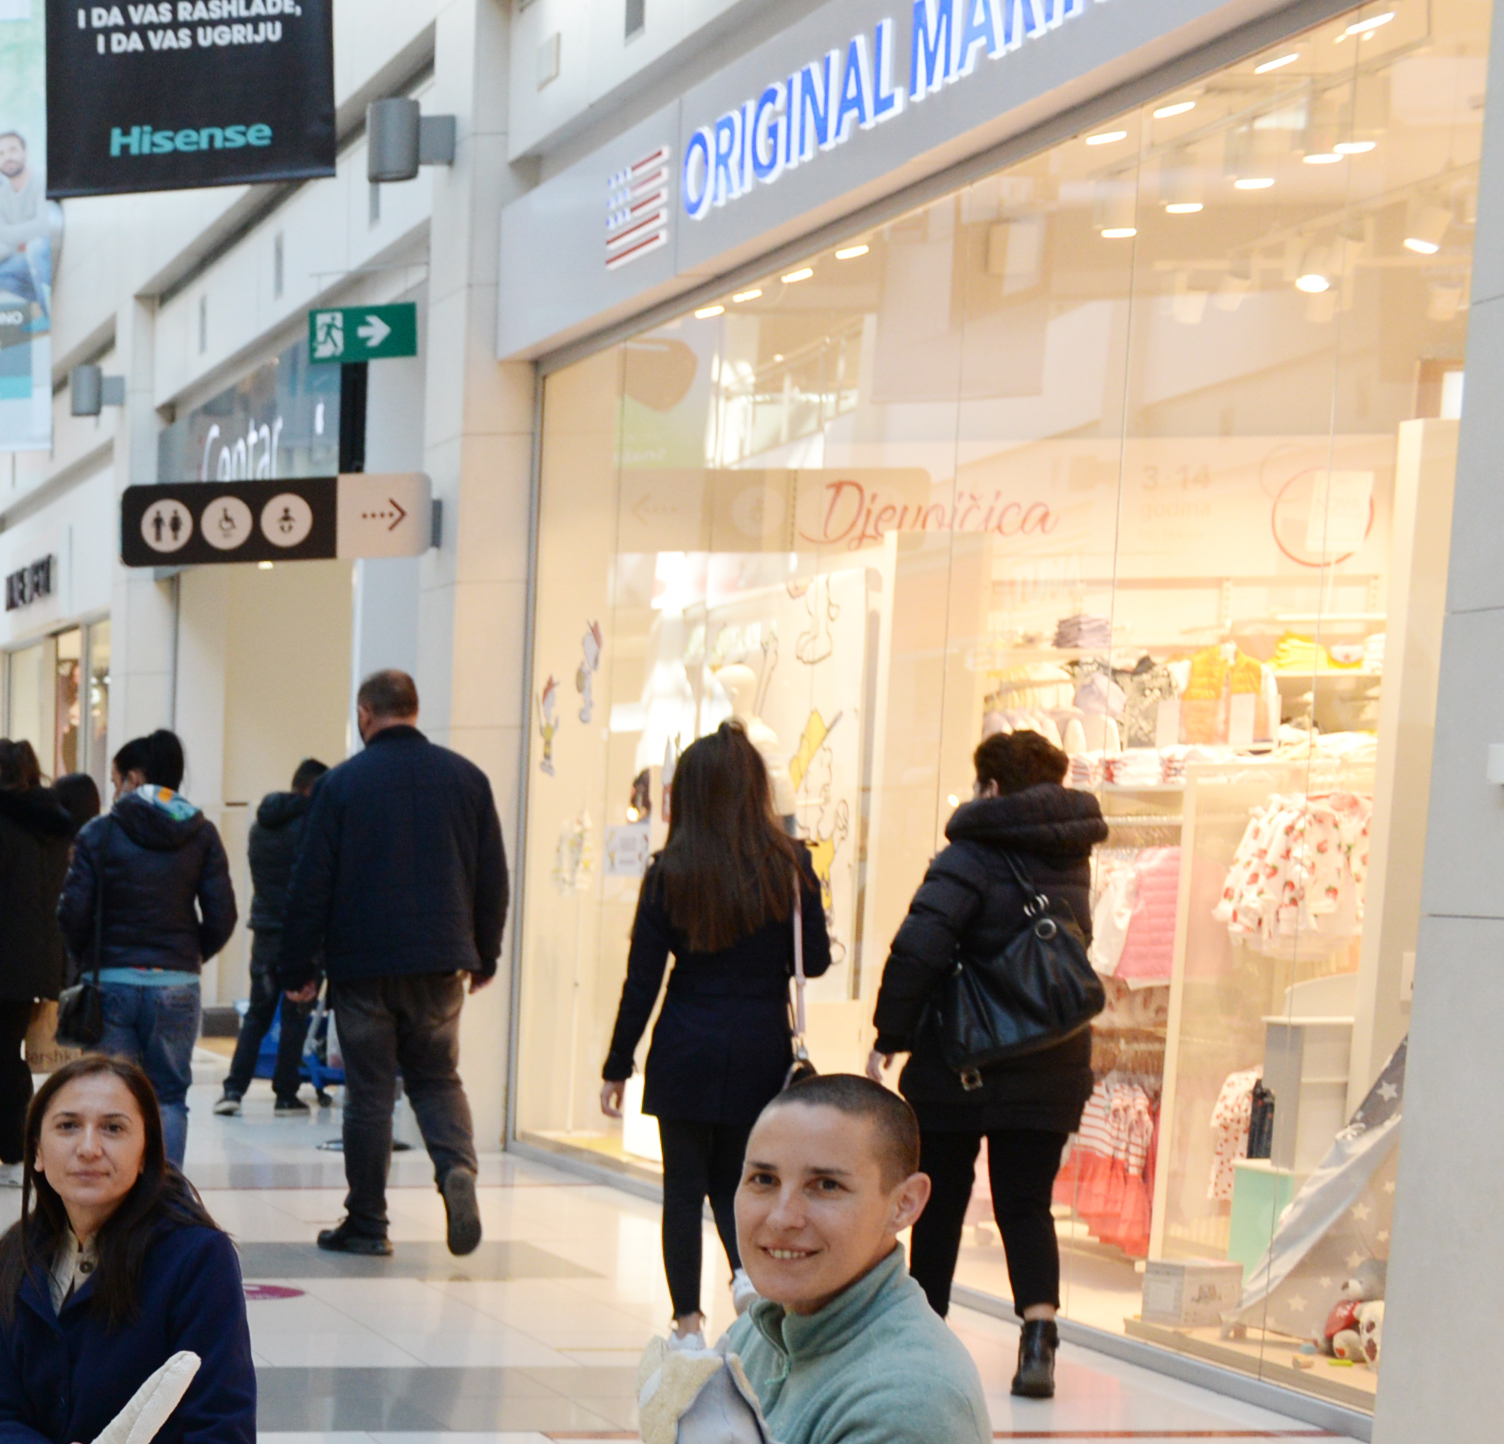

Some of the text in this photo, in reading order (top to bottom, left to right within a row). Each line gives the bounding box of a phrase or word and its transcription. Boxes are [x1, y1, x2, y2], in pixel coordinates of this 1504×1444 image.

[78, 0, 302, 29] I DA VAS RASHLADE,
[97, 21, 283, 55] I DA VAS UGRIJU
[683, 17, 908, 221] ORIGINAL
[110, 123, 273, 157] Hisense
